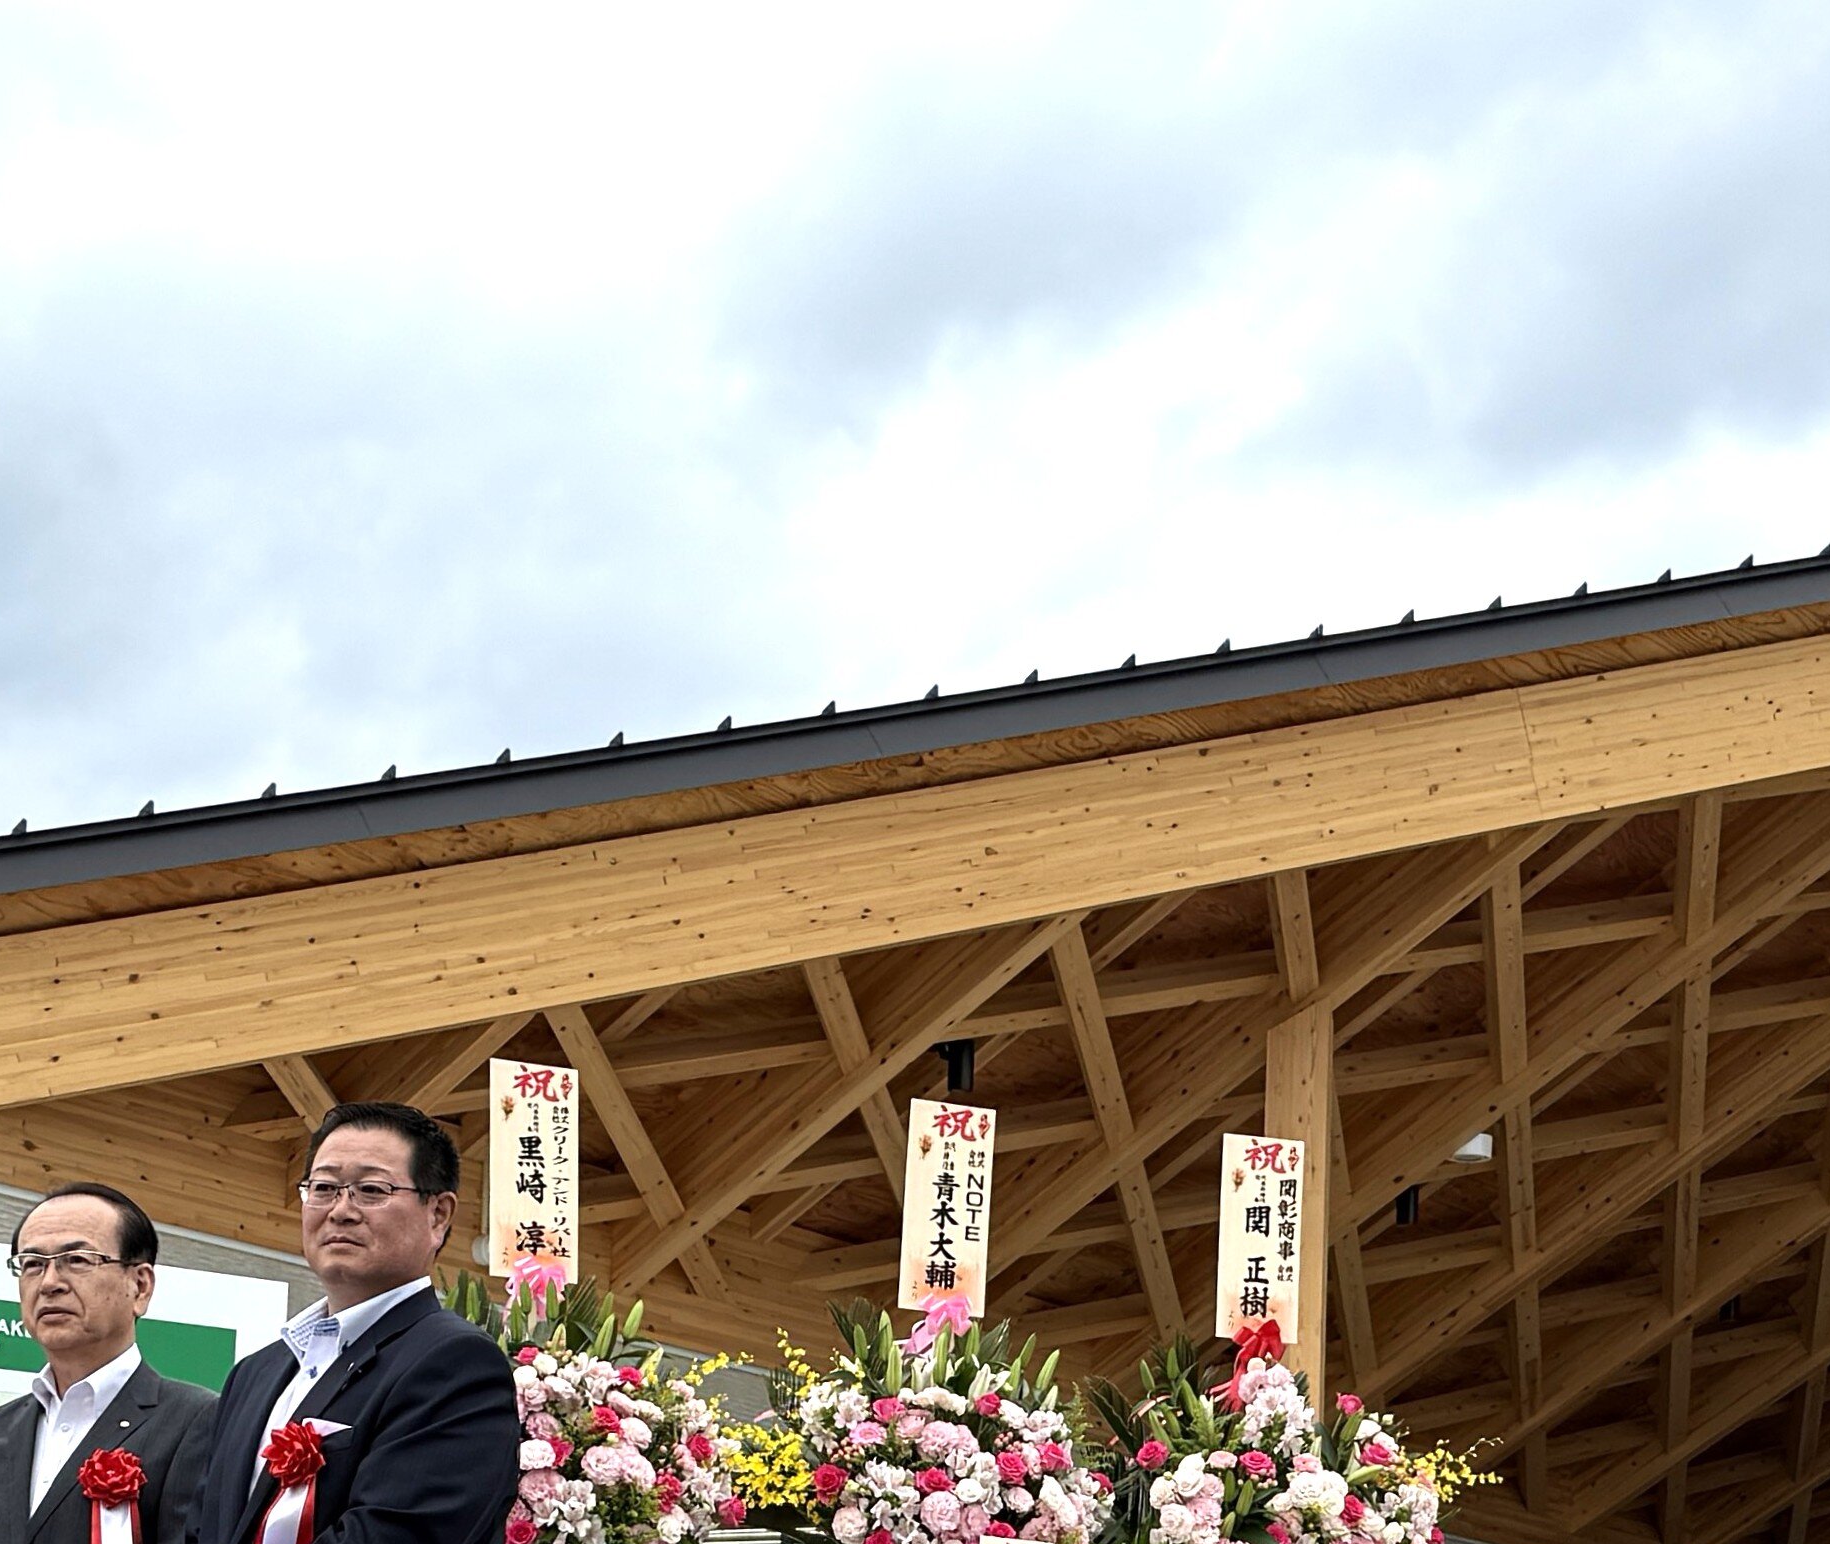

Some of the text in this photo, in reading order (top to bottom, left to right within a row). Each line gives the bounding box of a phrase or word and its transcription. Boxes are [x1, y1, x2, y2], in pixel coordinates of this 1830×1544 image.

[513, 1064, 560, 1102] 祝
[932, 1104, 977, 1142] 祝
[1243, 1138, 1287, 1174] 祝
[924, 1171, 960, 1290] 青木大輔
